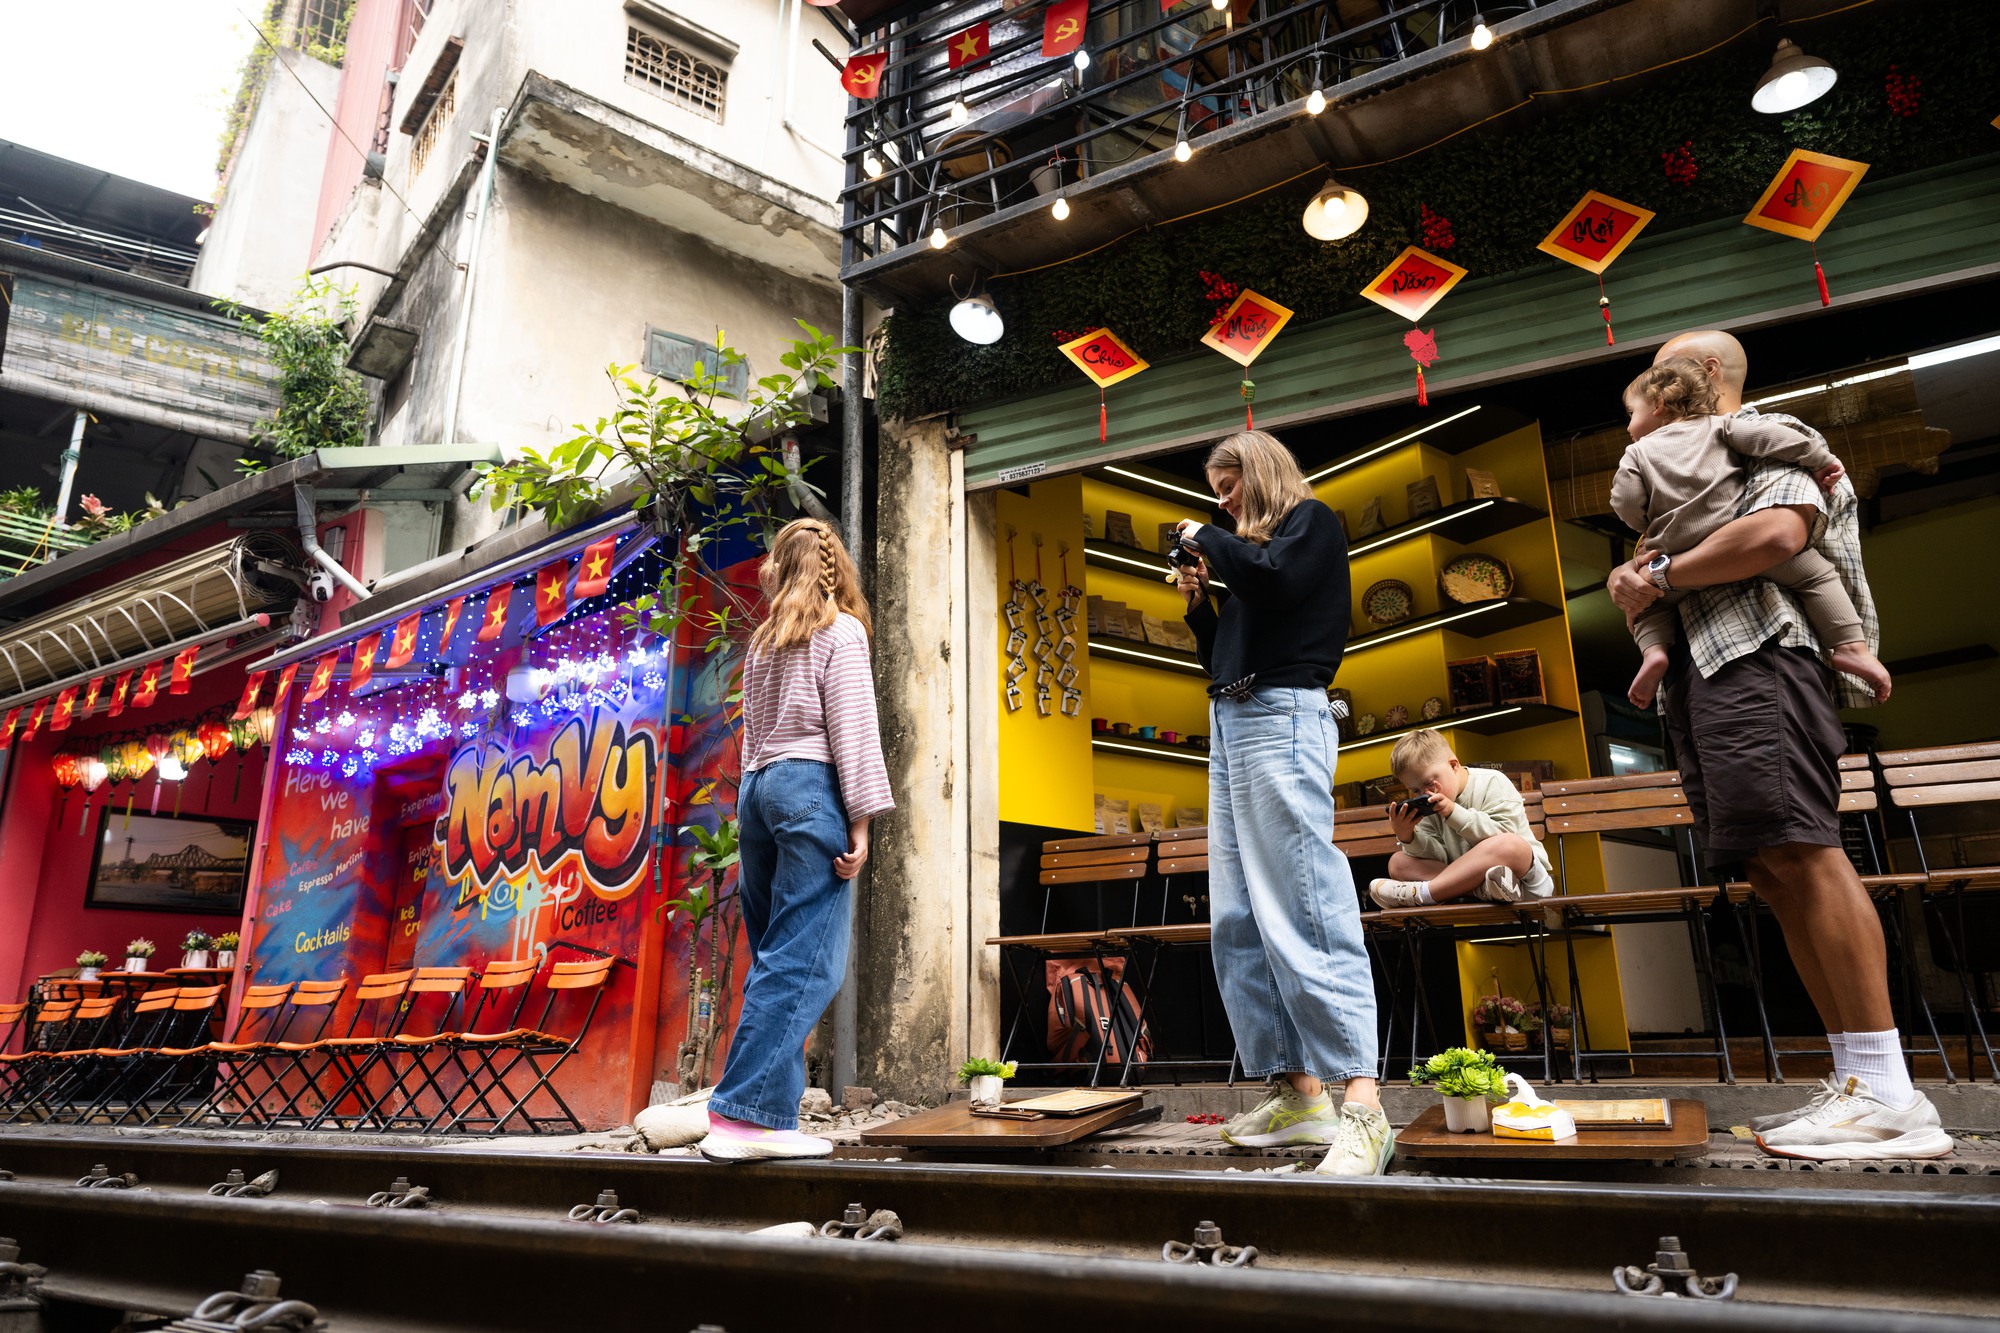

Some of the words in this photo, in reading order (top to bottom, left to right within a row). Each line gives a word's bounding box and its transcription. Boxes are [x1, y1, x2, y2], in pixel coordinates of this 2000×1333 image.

[285, 768, 333, 799] Here
[321, 788, 349, 812] we
[330, 813, 370, 842] have
[408, 844, 432, 866] Enjoy
[298, 872, 334, 894] Espresso
[335, 848, 363, 877] Martini
[265, 899, 293, 918] Cake
[400, 905, 416, 921] Ice
[561, 898, 618, 931] Coffee
[295, 922, 350, 954] Cocktails
